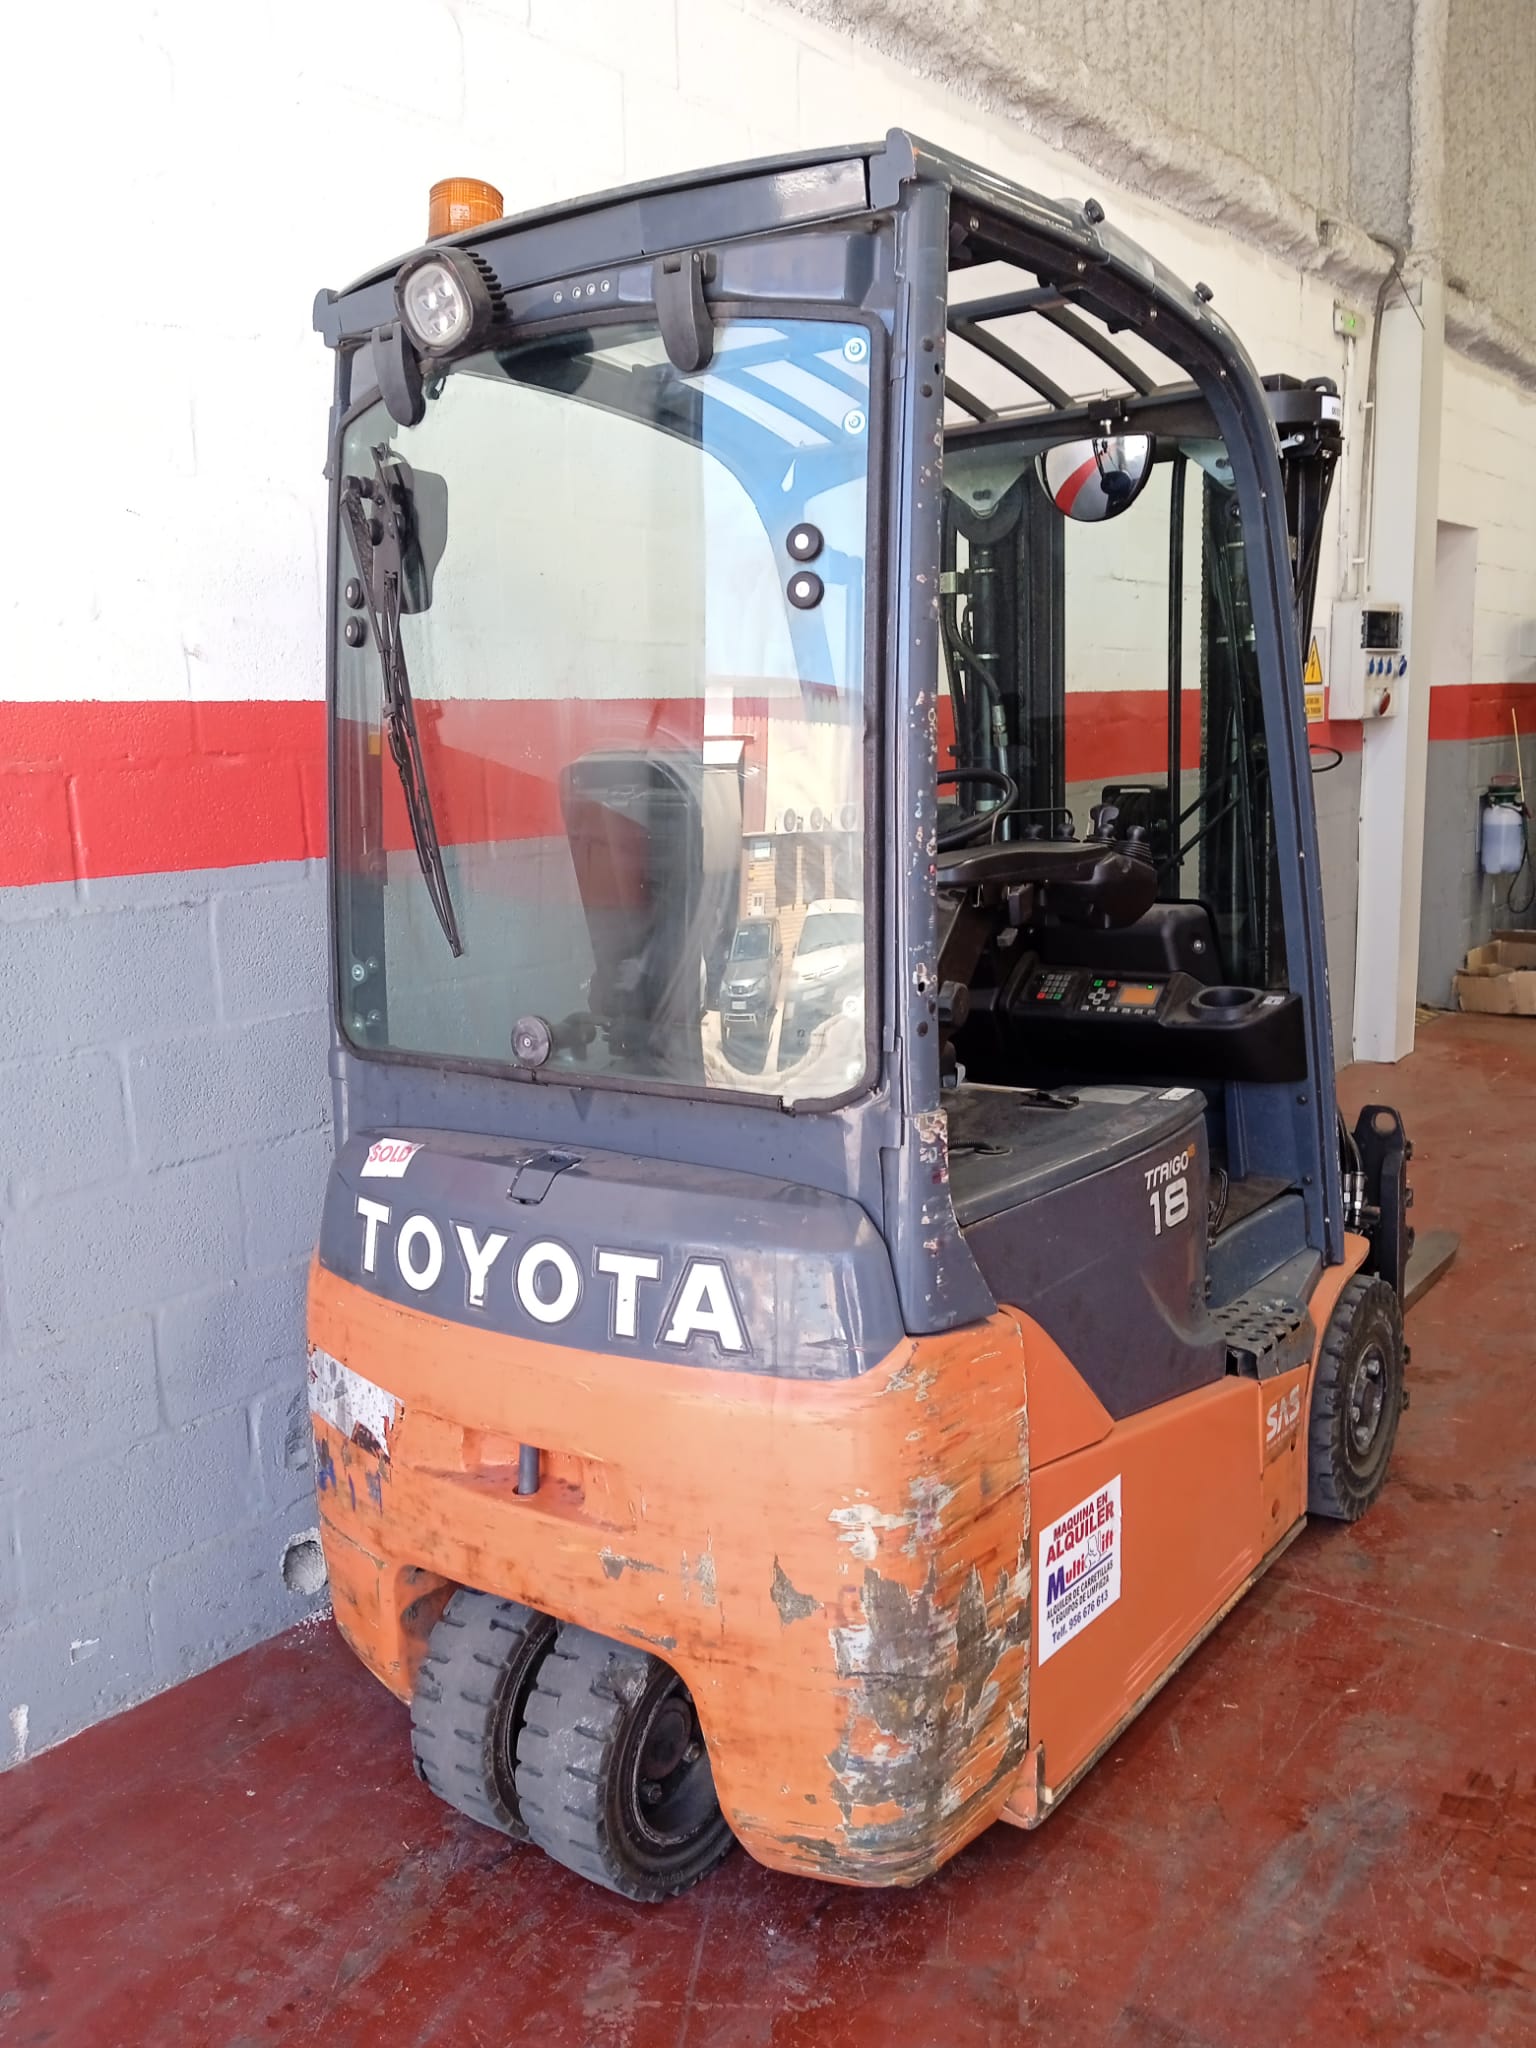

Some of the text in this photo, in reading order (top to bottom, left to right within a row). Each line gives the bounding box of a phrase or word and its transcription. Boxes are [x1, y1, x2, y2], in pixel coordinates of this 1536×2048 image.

[369, 1144, 413, 1162] SOLD
[1150, 1176, 1189, 1236] 18
[356, 1196, 750, 1352] TOYOTA
[1266, 1383, 1300, 1442] SAS
[1046, 1500, 1115, 1568] ALQUILER
[1053, 1491, 1108, 1541] MAQUINA EN
[1047, 1560, 1114, 1620] ALQUILER DE CARRETILLAS
[1055, 1599, 1079, 1625] EQUIPOS
[1079, 1592, 1087, 1605] DE
[1087, 1574, 1110, 1599] LIMPIEZA
[1068, 1611, 1082, 1630] 956
[1082, 1600, 1096, 1618] 676
[1096, 1589, 1109, 1607] 613
